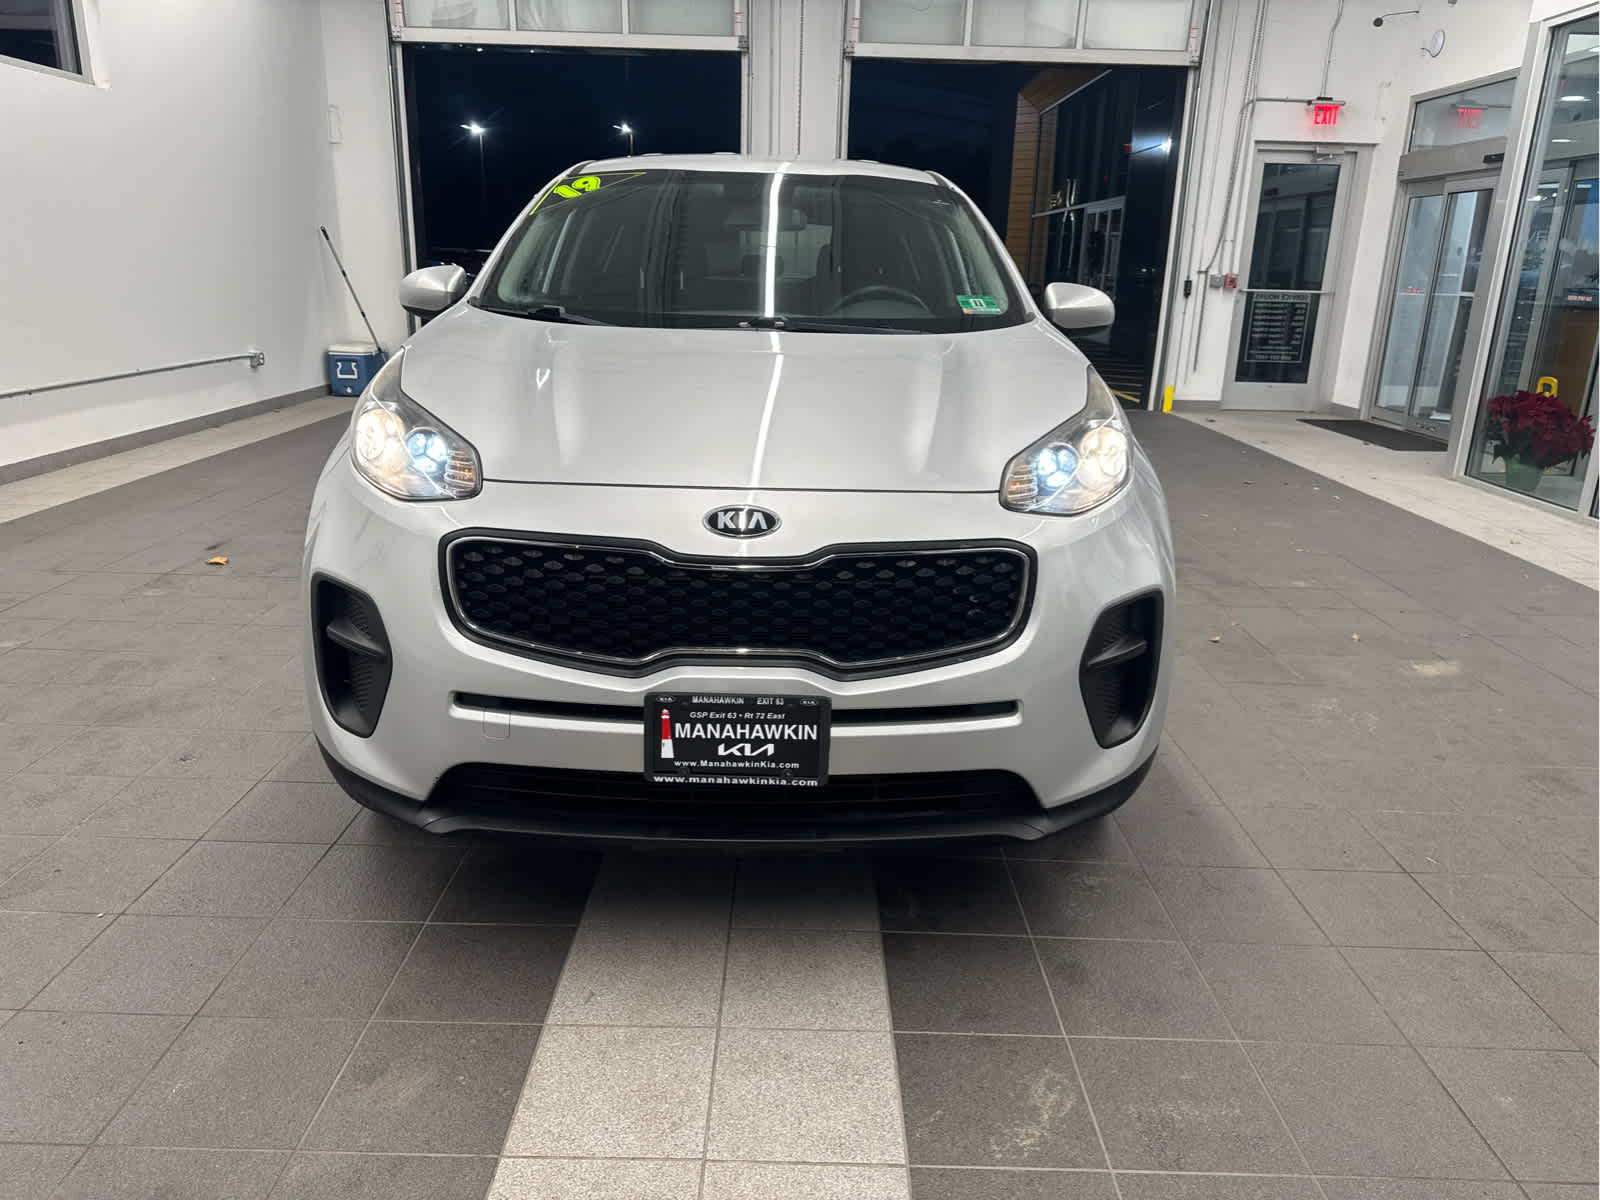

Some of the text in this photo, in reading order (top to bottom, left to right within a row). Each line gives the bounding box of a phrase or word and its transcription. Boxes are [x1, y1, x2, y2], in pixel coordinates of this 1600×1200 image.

[1314, 104, 1340, 125] EXIT
[553, 175, 601, 199] 19
[717, 511, 768, 530] KIA
[691, 695, 744, 704] MANAHAWKIN
[757, 697, 774, 705] EXIT
[689, 711, 708, 719] GSP
[709, 711, 726, 719] Exit
[755, 712, 765, 720] 72
[767, 712, 786, 720] East
[675, 723, 817, 740] MANAHAWKIN
[674, 760, 800, 769] www.ManahawkinKia.com
[653, 776, 818, 786] www.manahawkinkia.com
